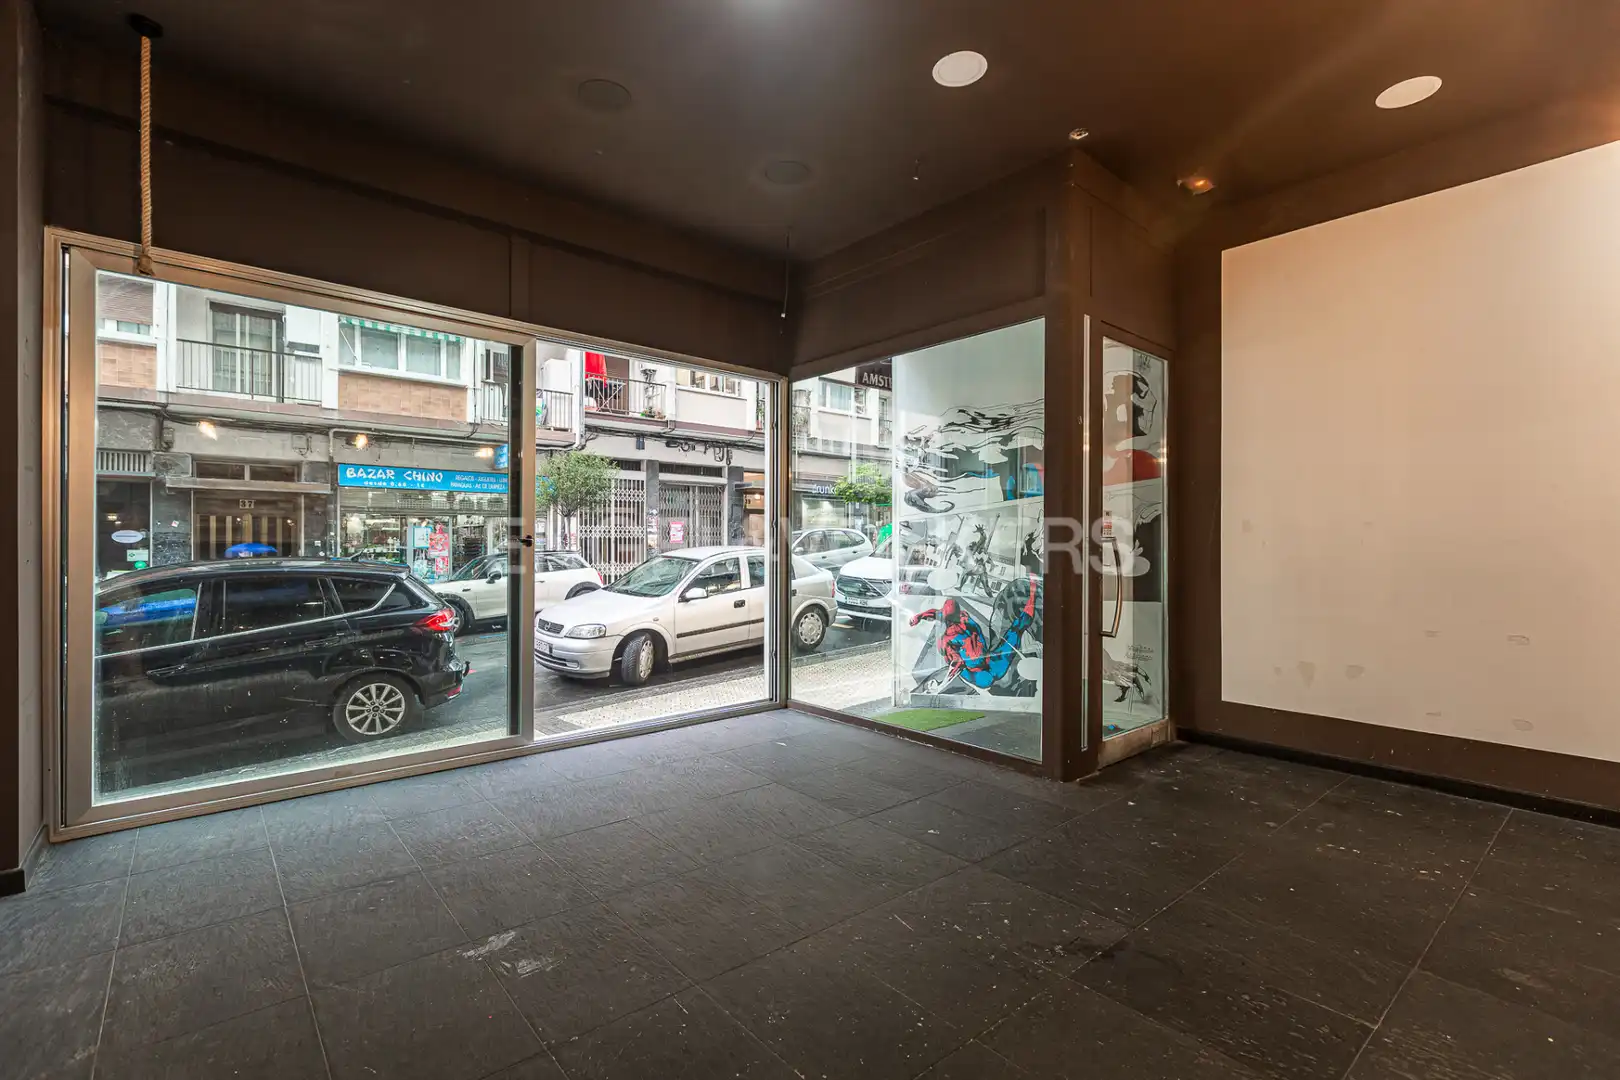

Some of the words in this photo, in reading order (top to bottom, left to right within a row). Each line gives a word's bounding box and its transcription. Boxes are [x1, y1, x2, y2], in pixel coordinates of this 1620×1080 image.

[346, 467, 395, 480] BAZAR
[403, 471, 443, 483] CHINO
[240, 500, 253, 508] 37
